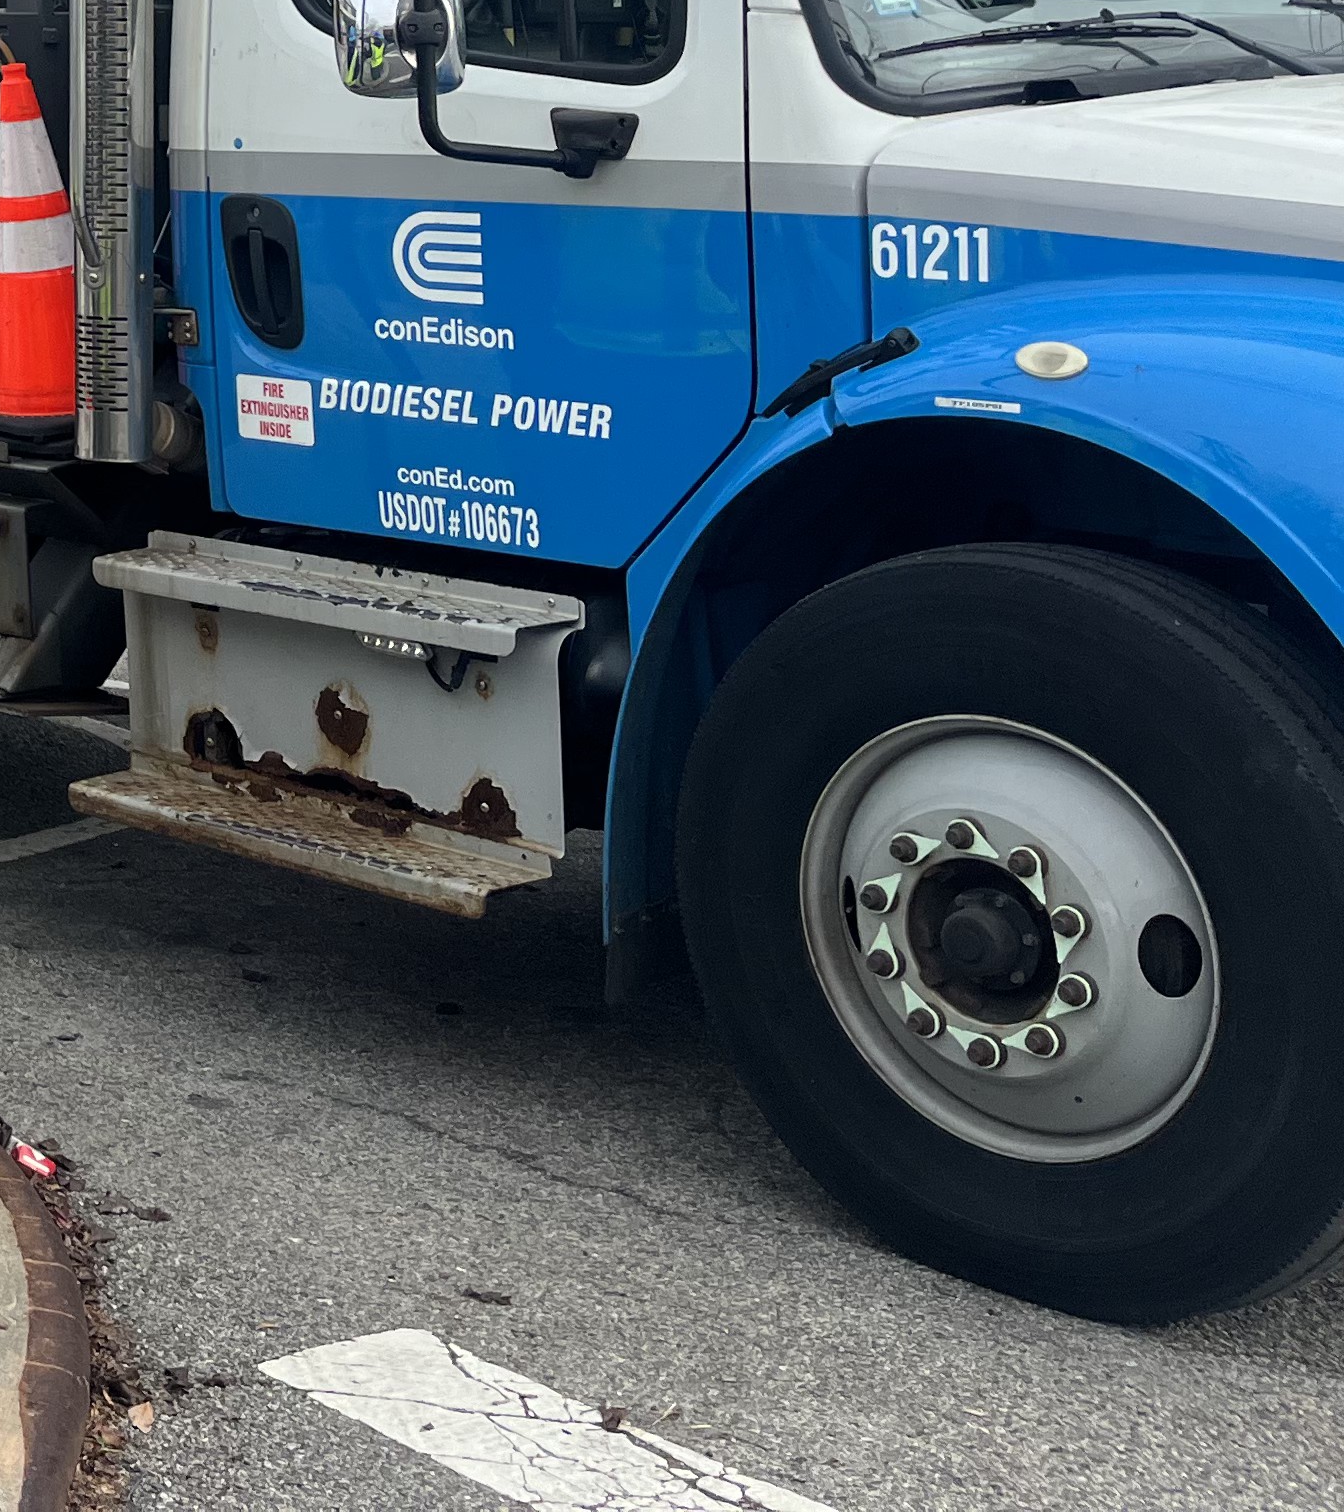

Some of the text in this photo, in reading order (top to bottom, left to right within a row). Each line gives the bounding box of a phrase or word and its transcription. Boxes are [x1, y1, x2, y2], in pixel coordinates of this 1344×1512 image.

[872, 222, 989, 283] 61211
[374, 316, 515, 350] conEdison
[262, 382, 285, 399] FIRE
[241, 400, 310, 421] EXTINGUISHER
[319, 377, 613, 440] BIODIESEL POWER
[259, 419, 293, 439] INSIDE
[396, 466, 516, 497] conEd.com
